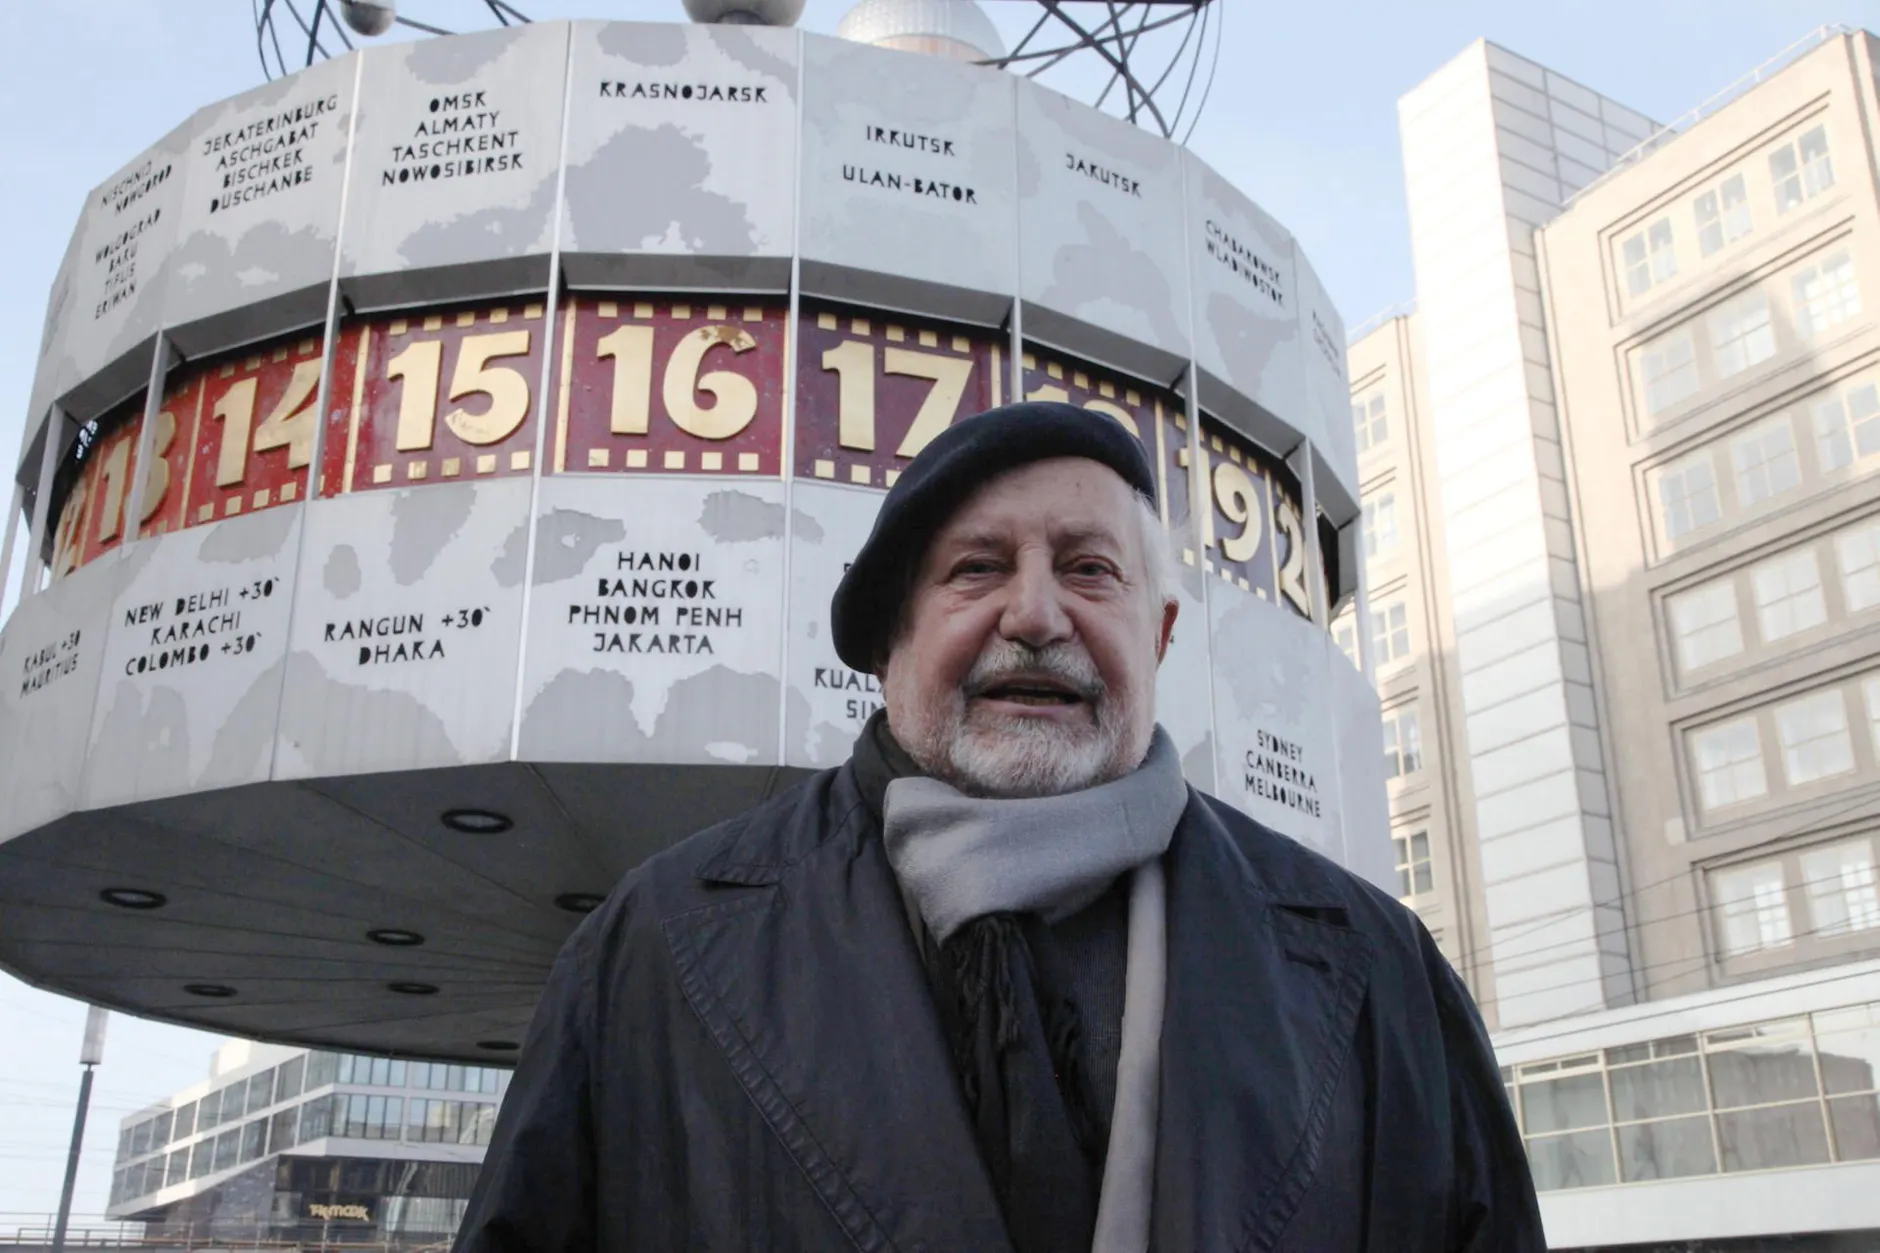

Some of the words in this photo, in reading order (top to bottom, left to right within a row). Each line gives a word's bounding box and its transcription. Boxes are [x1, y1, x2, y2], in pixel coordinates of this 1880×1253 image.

[429, 91, 487, 114] OMSK
[600, 80, 768, 103] KRASNOJARSK
[203, 94, 338, 156] JEKATERINBURG
[413, 110, 500, 138] ALMATY
[866, 125, 956, 157] IRKUTSK
[215, 121, 320, 172] ASCHGABAT
[393, 131, 519, 162] TASCHKENT
[222, 148, 304, 189] BISCHKER
[381, 153, 524, 186] NOWOSIBIRSK
[843, 164, 978, 206] ULAN-BATOR
[1066, 153, 1143, 200] JAKUTSK
[209, 165, 314, 214] DUSCHANBE
[387, 329, 532, 450] 15
[596, 324, 758, 440] 16
[822, 340, 975, 458] 17
[213, 358, 322, 488] 14
[618, 552, 701, 572] HANOI
[598, 579, 717, 600] BANGKOK
[124, 602, 164, 628] NEW
[175, 587, 230, 617] DELHI
[568, 605, 661, 626] PHNOM
[675, 607, 743, 628] PENH
[150, 611, 242, 646] KARACHI
[324, 614, 424, 643] RANGUN
[592, 632, 714, 656] JAKARTA
[125, 643, 211, 677] COLOMBO
[359, 640, 445, 666] DHAKA
[1257, 728, 1304, 764] SYDNEY
[1246, 750, 1318, 793] CANBERRA
[1245, 773, 1322, 818] MELBOURNE
